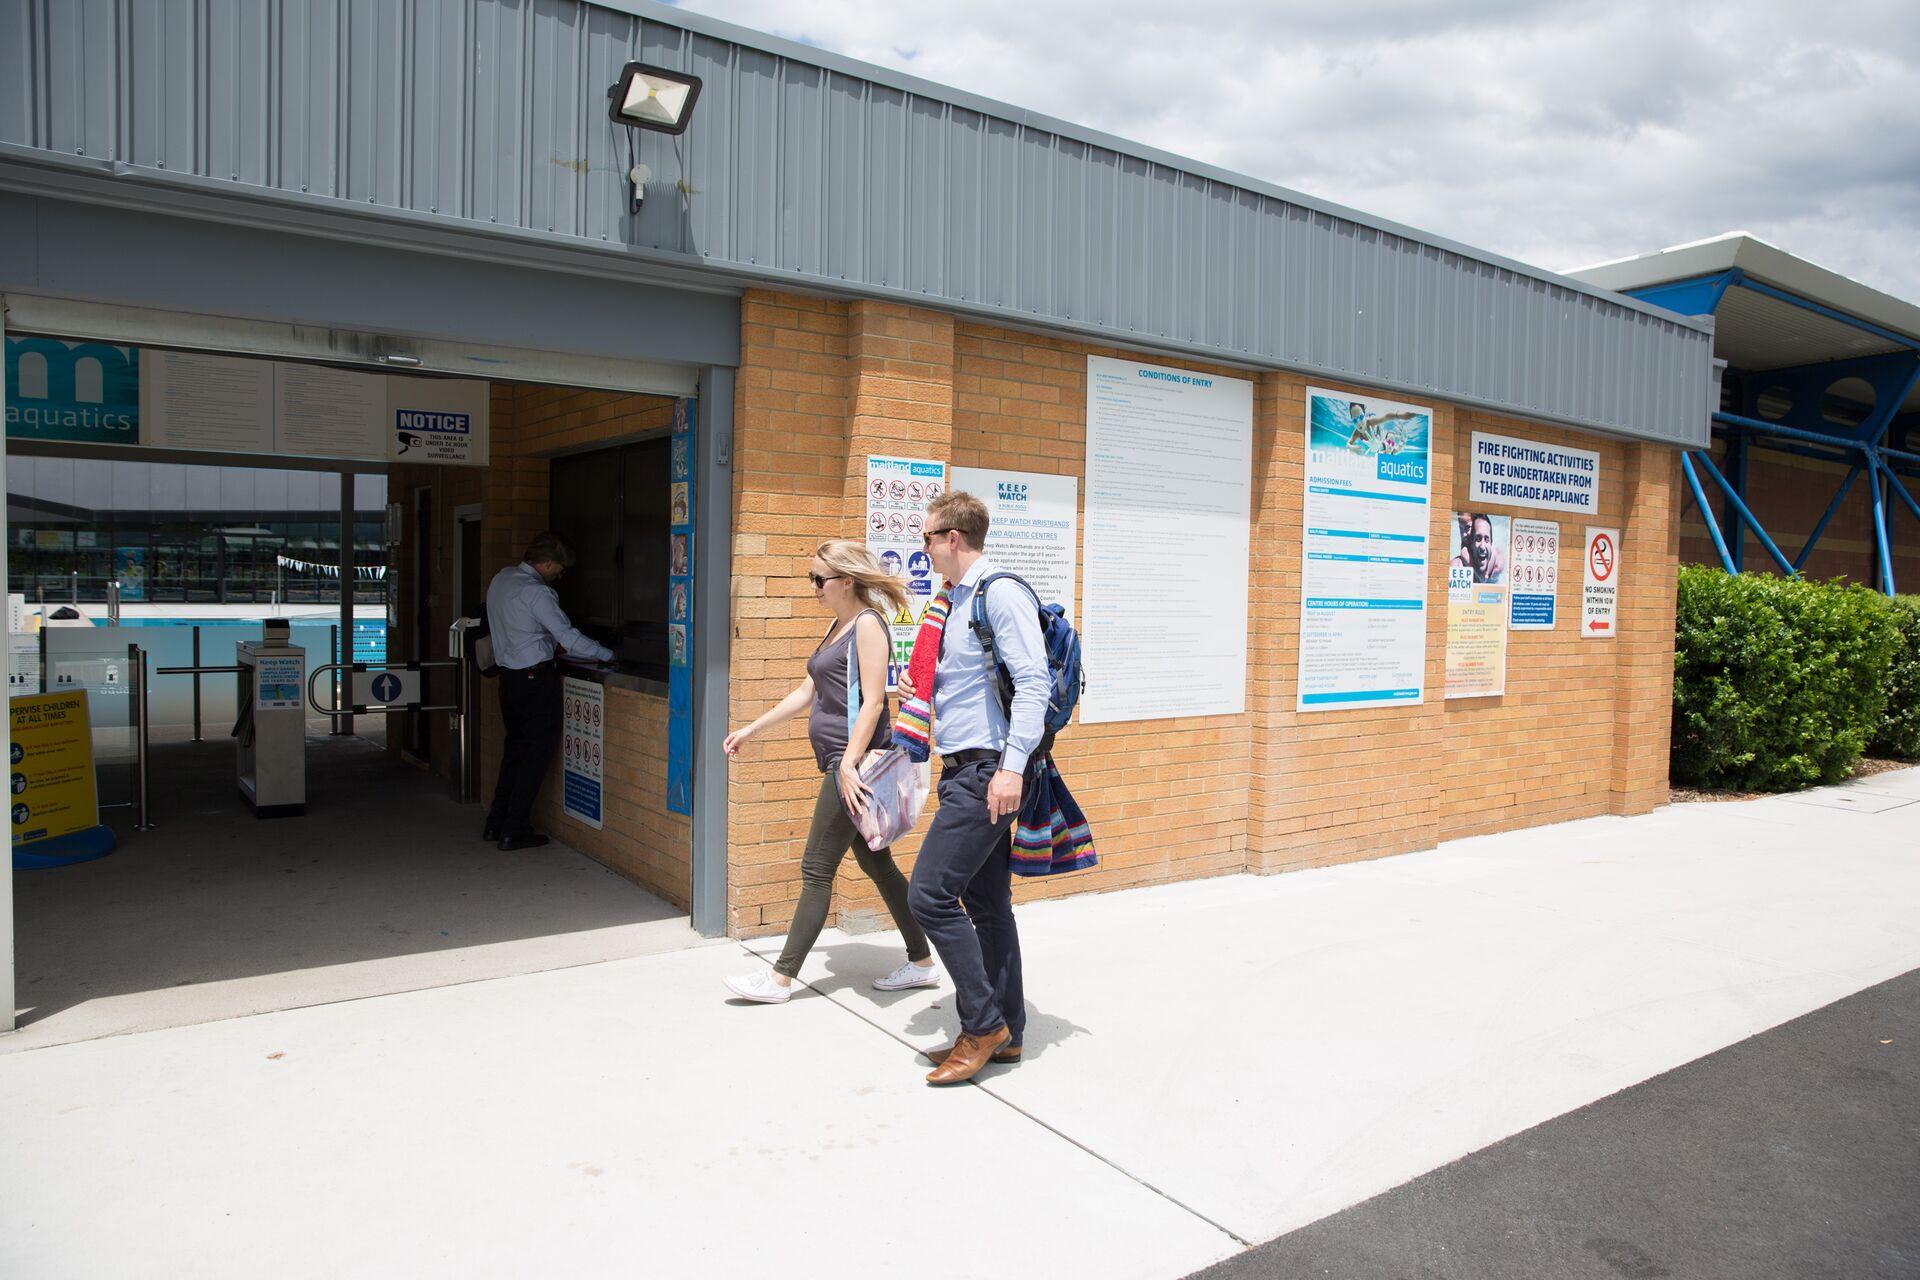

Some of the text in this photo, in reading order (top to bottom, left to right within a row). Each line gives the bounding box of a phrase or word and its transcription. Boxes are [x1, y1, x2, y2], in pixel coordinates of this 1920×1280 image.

[1138, 369, 1181, 384] CONDITIONS
[1182, 375, 1191, 384] OF
[1192, 377, 1213, 388] ENTRY
[6, 405, 131, 431] aquatics
[400, 413, 466, 431] NOTICE
[1478, 441, 1594, 471] FIRE FIGHTING ACTIVITIES
[870, 460, 941, 475] maitland aquatics
[1380, 461, 1424, 479] aquatics
[1478, 461, 1592, 488] TO BE UNDERTAKEN FROM
[998, 483, 1027, 492] KEEP
[1309, 476, 1352, 487] ADMISSION FEES
[998, 492, 1027, 502] WATCH
[1479, 480, 1590, 506] THE BRIGADE APPLIANCE
[1032, 519, 1070, 527] WRISTBANDS
[1452, 569, 1471, 578] EEP
[1593, 586, 1615, 594] SMOKING
[10, 700, 80, 716] PERVISE CHILDREN
[17, 711, 66, 724] AT ALL TIMES
